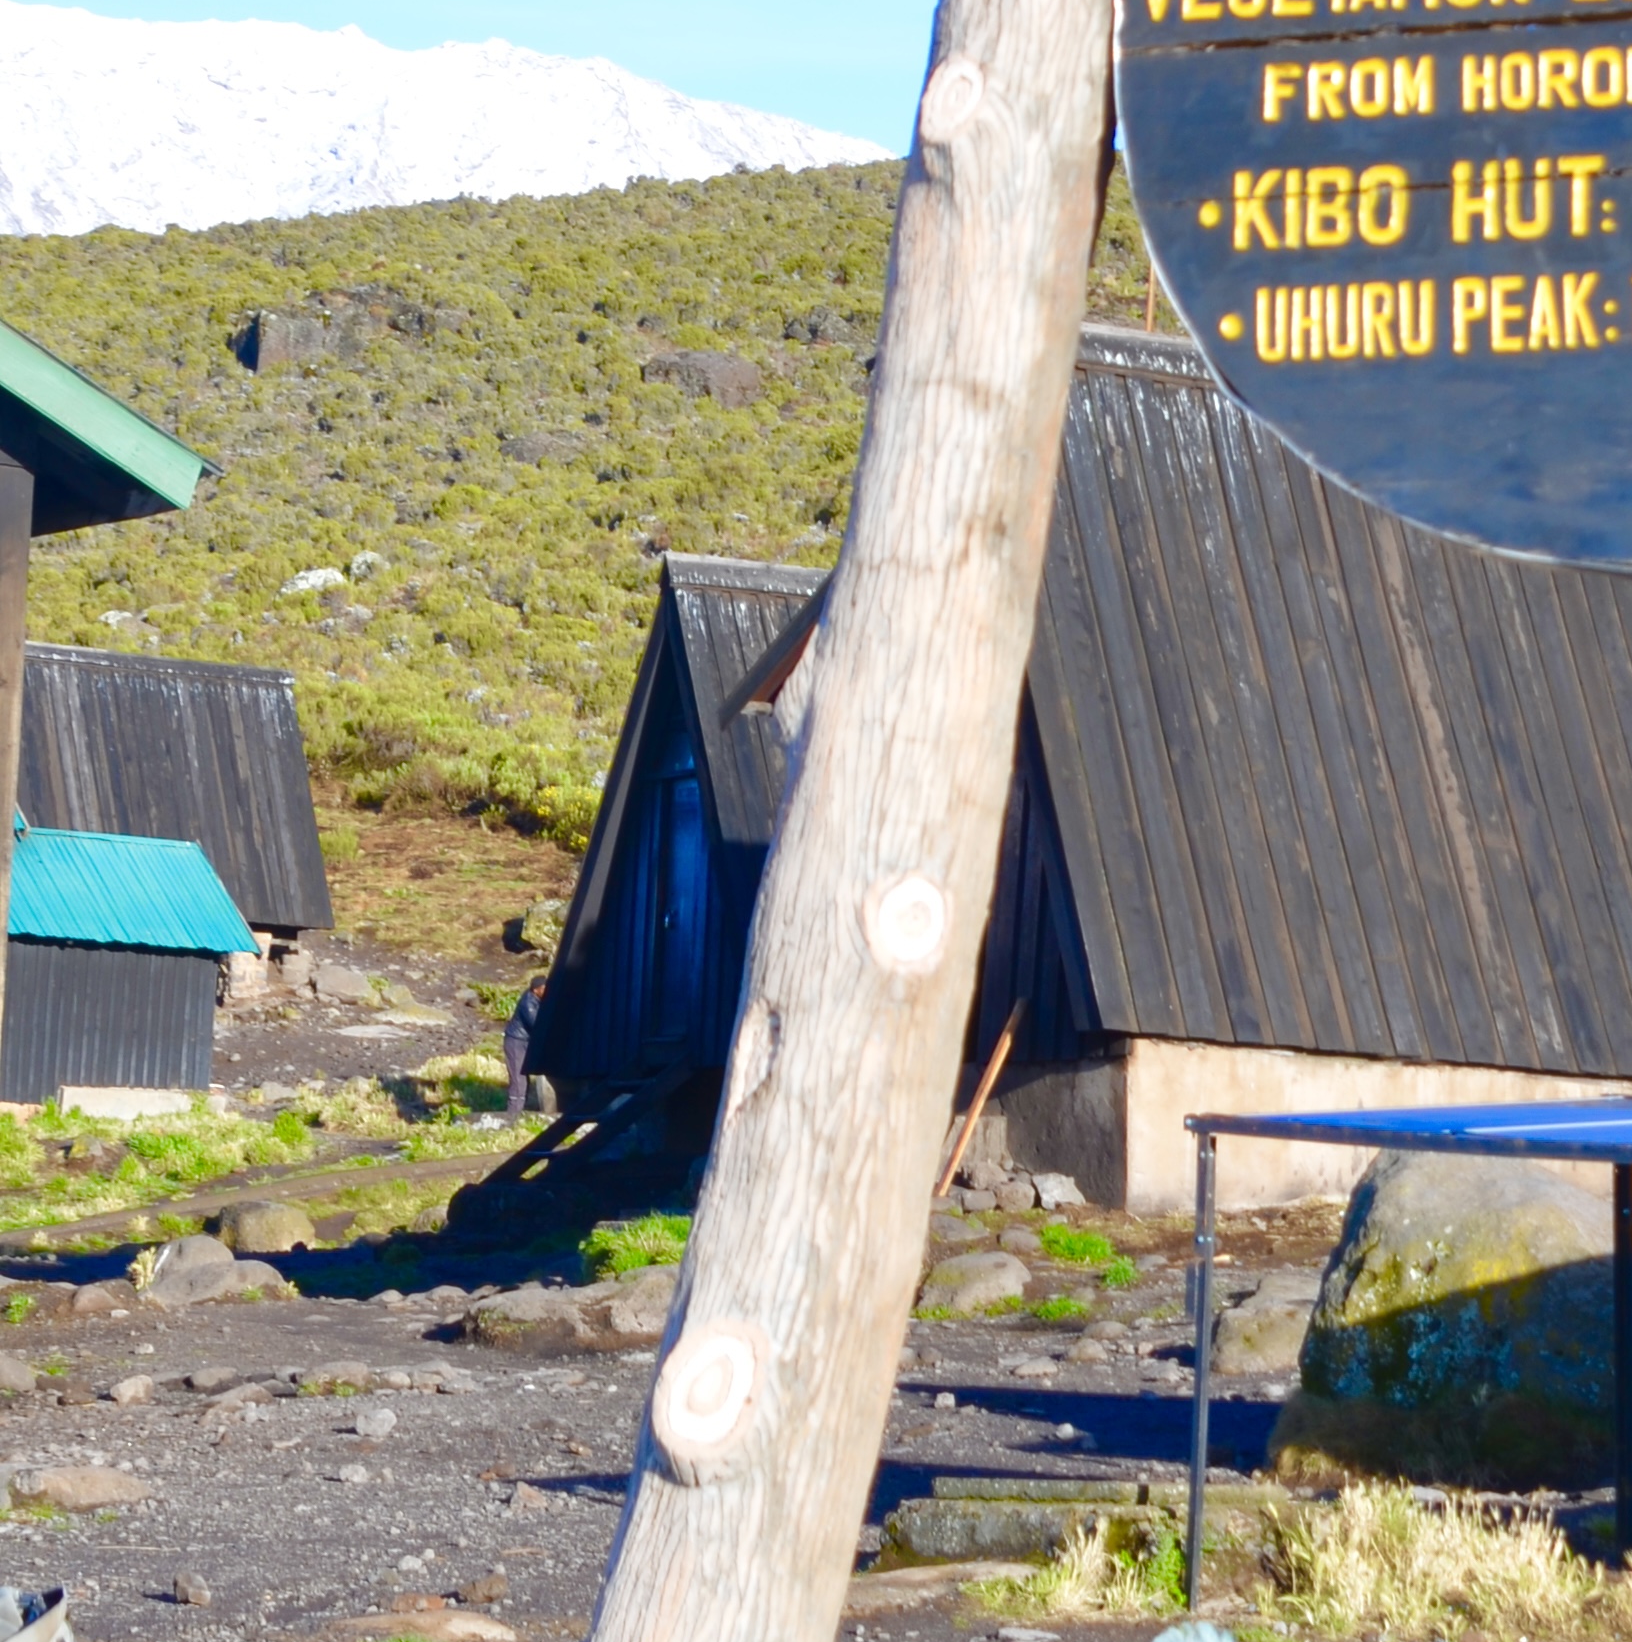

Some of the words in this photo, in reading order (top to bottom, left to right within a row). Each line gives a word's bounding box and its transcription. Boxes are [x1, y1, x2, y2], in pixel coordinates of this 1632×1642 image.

[1260, 53, 1437, 125] FROM
[1230, 162, 1413, 253] KIBO
[1449, 153, 1619, 245] HUT:
[1253, 277, 1438, 365] UHURU
[1450, 270, 1622, 357] PEAK:
